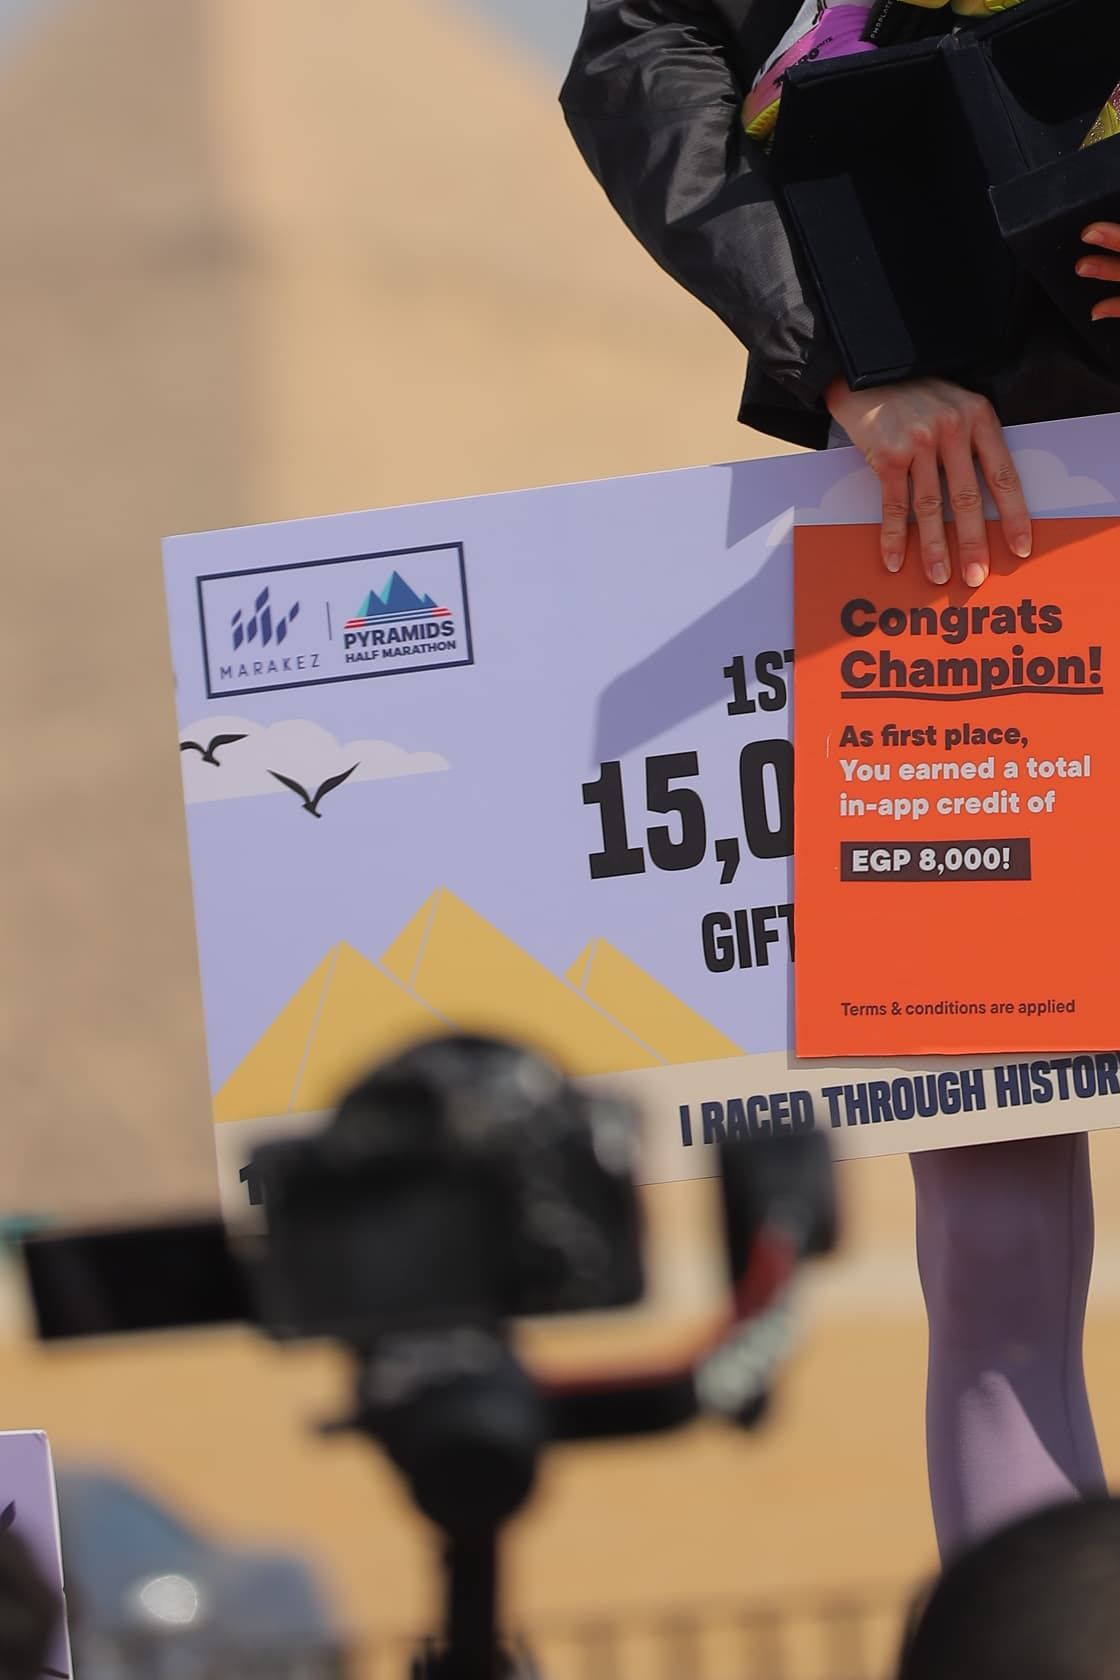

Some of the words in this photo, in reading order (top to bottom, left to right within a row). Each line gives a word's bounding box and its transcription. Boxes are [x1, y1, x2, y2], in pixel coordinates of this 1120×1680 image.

[344, 620, 456, 650] PYRAMIDS
[840, 598, 1063, 644] Congrats
[345, 649, 380, 664] HALF
[382, 640, 457, 658] MARATHON
[220, 654, 321, 681] MARAKEZ
[841, 645, 1102, 694] Champion!
[839, 725, 874, 747] As
[881, 724, 937, 747] first
[945, 723, 1029, 750] place,
[839, 759, 891, 782] You
[899, 757, 995, 780] earned
[1003, 761, 1019, 779] a
[1027, 755, 1091, 778] total
[839, 793, 929, 820] in-app
[936, 790, 1021, 814] credit
[1027, 790, 1056, 813] of
[852, 849, 912, 872] EGP
[919, 847, 1011, 875] 8,000!
[841, 1002, 887, 1016] Terms
[891, 1002, 902, 1015] &
[905, 1001, 987, 1015] conditions
[990, 1003, 1015, 1015] are
[1018, 1000, 1076, 1017] applied
[679, 1105, 692, 1147] I
[702, 1090, 816, 1146] RACED
[821, 1069, 986, 1128] THROUGH
